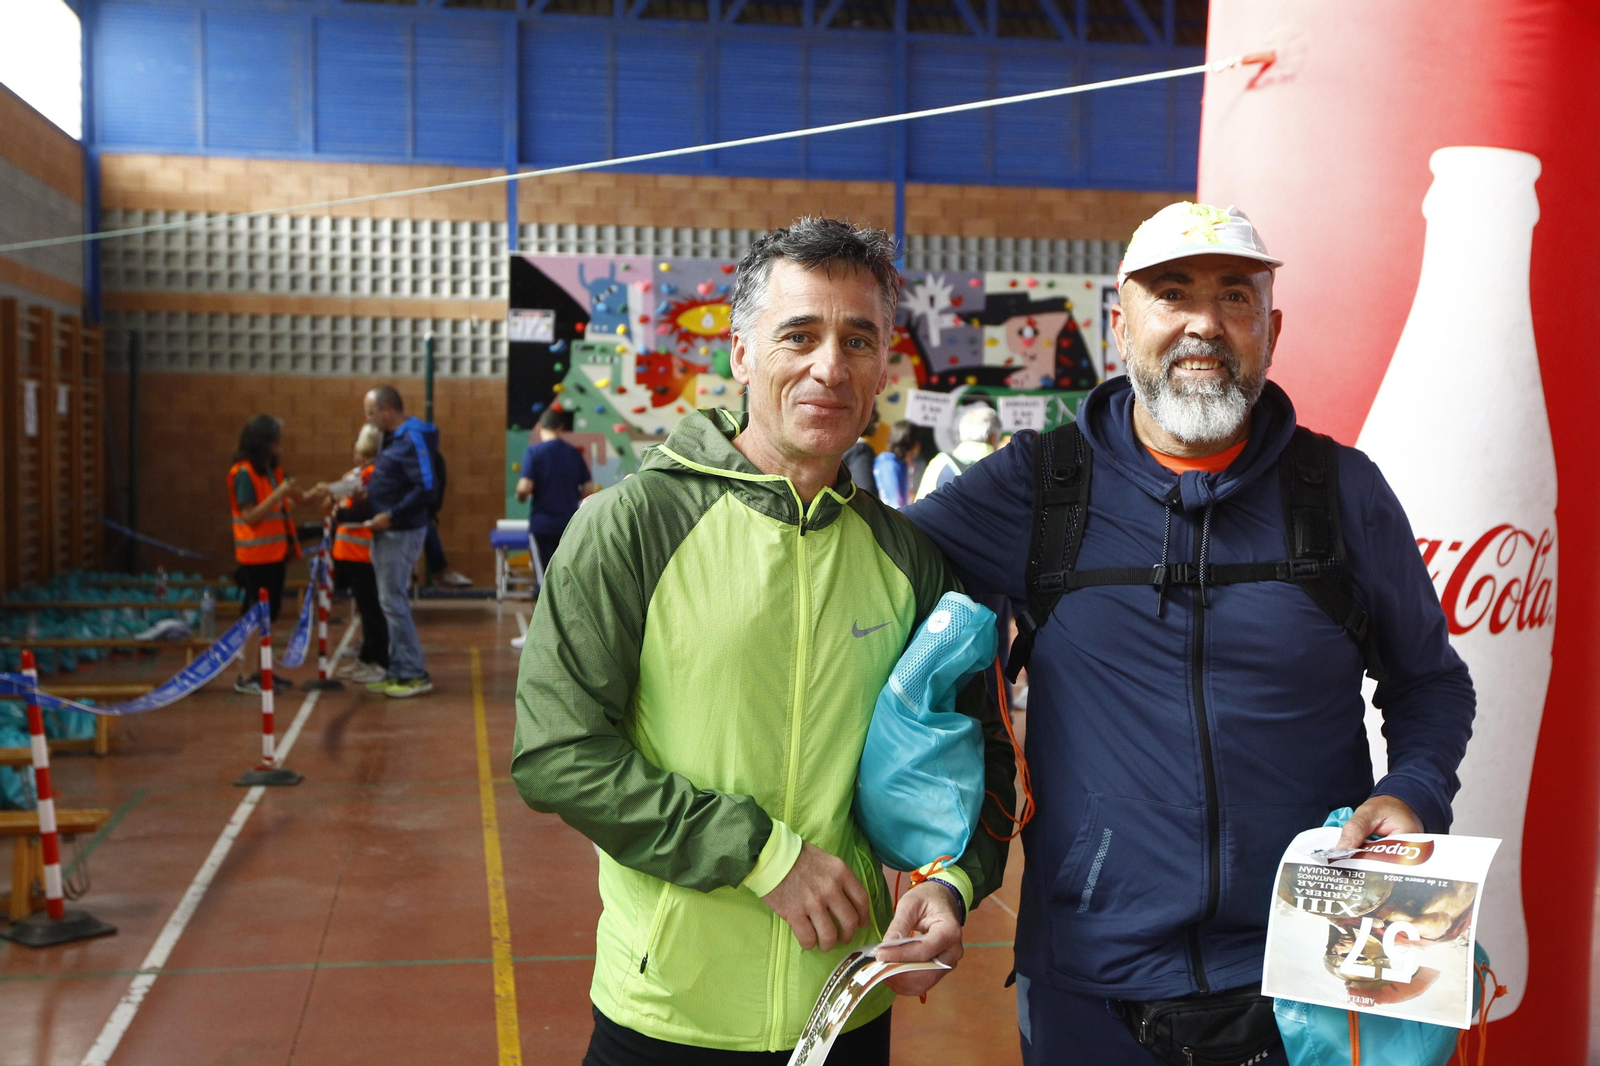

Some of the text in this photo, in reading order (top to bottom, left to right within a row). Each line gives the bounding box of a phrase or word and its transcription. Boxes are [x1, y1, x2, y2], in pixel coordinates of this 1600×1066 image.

[1297, 872, 1349, 884] ESPARTANOS
[1298, 865, 1366, 878] DEL ALQUIÁN
[1383, 874, 1404, 883] 2024
[1405, 876, 1426, 885] enero
[1438, 880, 1448, 888] 21
[1297, 879, 1363, 893] POPULAR
[1295, 887, 1362, 901] CARRERA
[1293, 896, 1361, 917] XIII
[1340, 917, 1420, 984] 57
